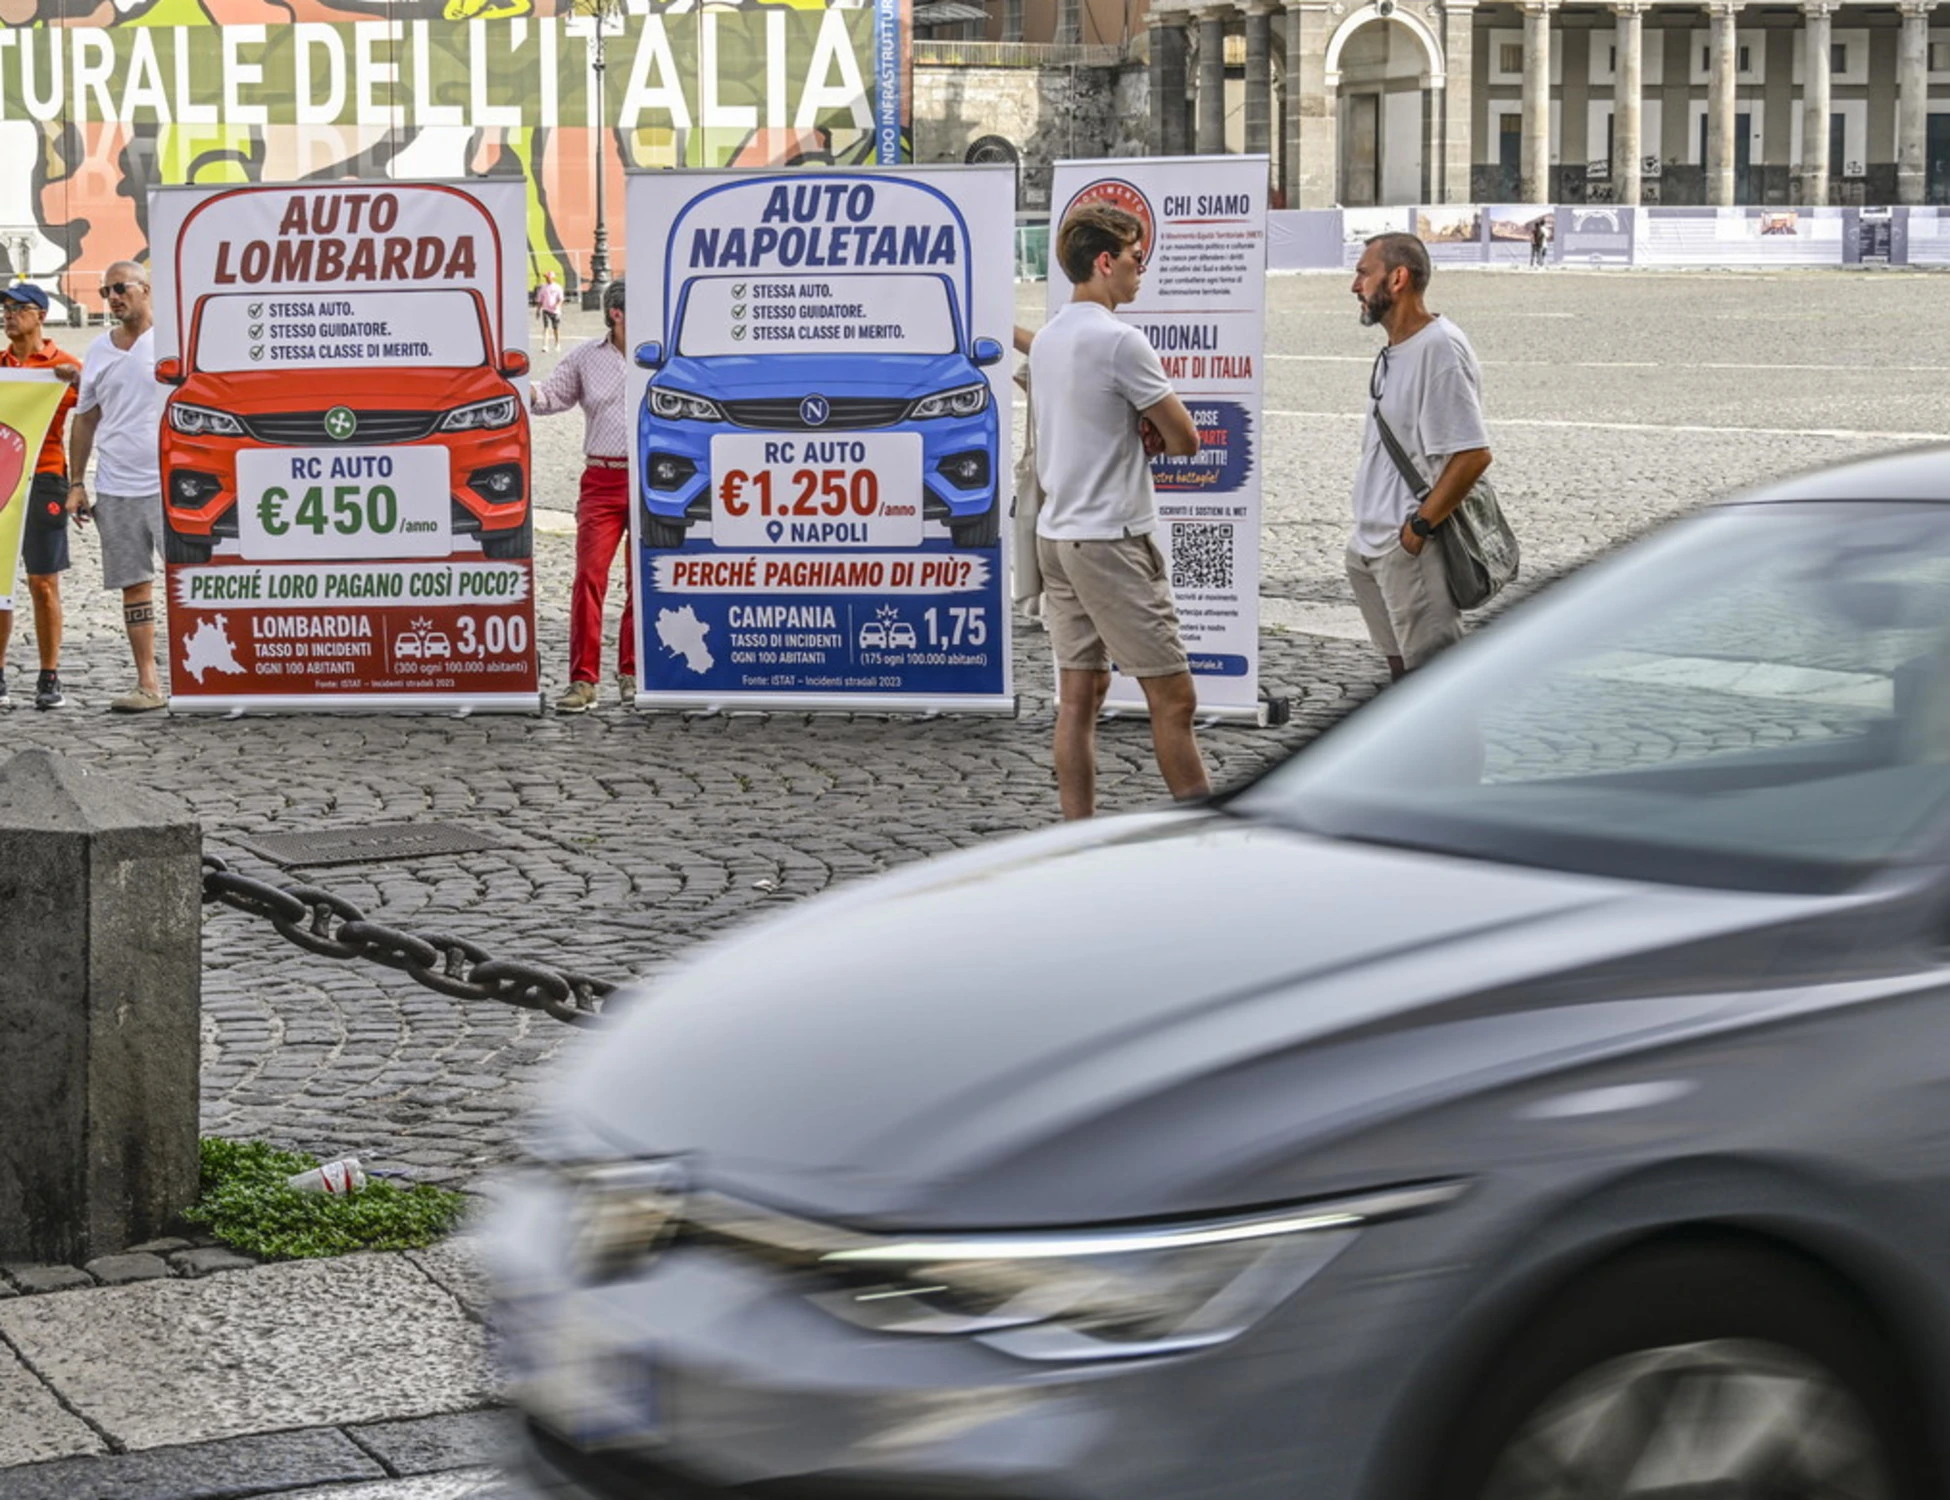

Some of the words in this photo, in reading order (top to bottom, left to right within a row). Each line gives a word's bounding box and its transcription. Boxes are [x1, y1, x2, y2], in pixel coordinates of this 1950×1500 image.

[295, 8, 876, 126] DELL'ITALIA
[761, 183, 875, 223] AUTO
[1077, 186, 1145, 212] OVIMENTO
[1163, 195, 1191, 216] CHI
[1197, 194, 1250, 216] SIAMO
[279, 193, 399, 236] AUTO
[689, 225, 956, 268] NAPOLETANA
[214, 236, 477, 285] LOMBARDA
[752, 284, 796, 299] STESSA
[798, 283, 833, 298] AUTO.
[269, 302, 316, 318] STESSA
[318, 301, 355, 317] AUTO.
[752, 305, 796, 320] STESSO
[799, 304, 866, 319] GUIDATORE.
[269, 324, 317, 340] STESSO
[319, 322, 392, 338] GUIDATORE.
[752, 326, 796, 341] STESSA
[798, 325, 840, 340] CLASSE
[843, 325, 856, 340] DI
[858, 324, 905, 339] MERITO.
[1132, 324, 1218, 351] DIONALI
[270, 345, 317, 361] STESSA
[318, 344, 365, 359] CLASSE
[367, 343, 380, 358] DI
[383, 342, 432, 358] MERITO.
[1192, 355, 1206, 378] DI
[1211, 355, 1253, 378] ITALIA
[805, 400, 823, 417] N
[764, 442, 797, 464] RC
[803, 441, 866, 464] AUTO
[291, 457, 322, 480] RC
[331, 456, 393, 478] AUTO
[719, 468, 879, 517] €1.250
[256, 485, 398, 536] €450
[792, 522, 868, 543] NAPOLI
[191, 569, 262, 600] PERCHÉ
[267, 574, 318, 599] LORO
[325, 572, 401, 598] PAGANO
[410, 566, 452, 597] COSÌ
[459, 571, 519, 597] POCO?
[673, 556, 757, 586] PERCHÉ
[764, 561, 884, 587] PAGHIAMO
[890, 561, 915, 587] DI
[920, 556, 972, 586] PIÙ?
[252, 615, 373, 639] LOMBARDIA
[728, 606, 836, 629] CAMPANIA
[924, 607, 987, 651] 1,75
[456, 615, 527, 659] 3,00
[731, 634, 767, 648] TASSO
[769, 634, 783, 648] DI
[785, 634, 842, 648] INCIDENTI
[254, 643, 292, 657] TASSO
[296, 643, 309, 657] DI
[312, 642, 372, 657] INCIDENTI
[731, 652, 756, 664] OGNI
[758, 652, 777, 664] 100
[778, 652, 826, 664] ABITANTI
[860, 652, 882, 666] (175
[884, 653, 905, 669] ogni
[907, 652, 946, 664] 100.000
[947, 652, 987, 666] abitanti)
[255, 662, 284, 674] OGNI
[285, 662, 305, 674] 100
[307, 661, 355, 674] ABITANTI
[418, 662, 442, 677] ogni
[444, 661, 484, 674] 100.000
[742, 674, 769, 685] Fonte:
[805, 675, 843, 686] Incidenti
[844, 675, 877, 687] stradali
